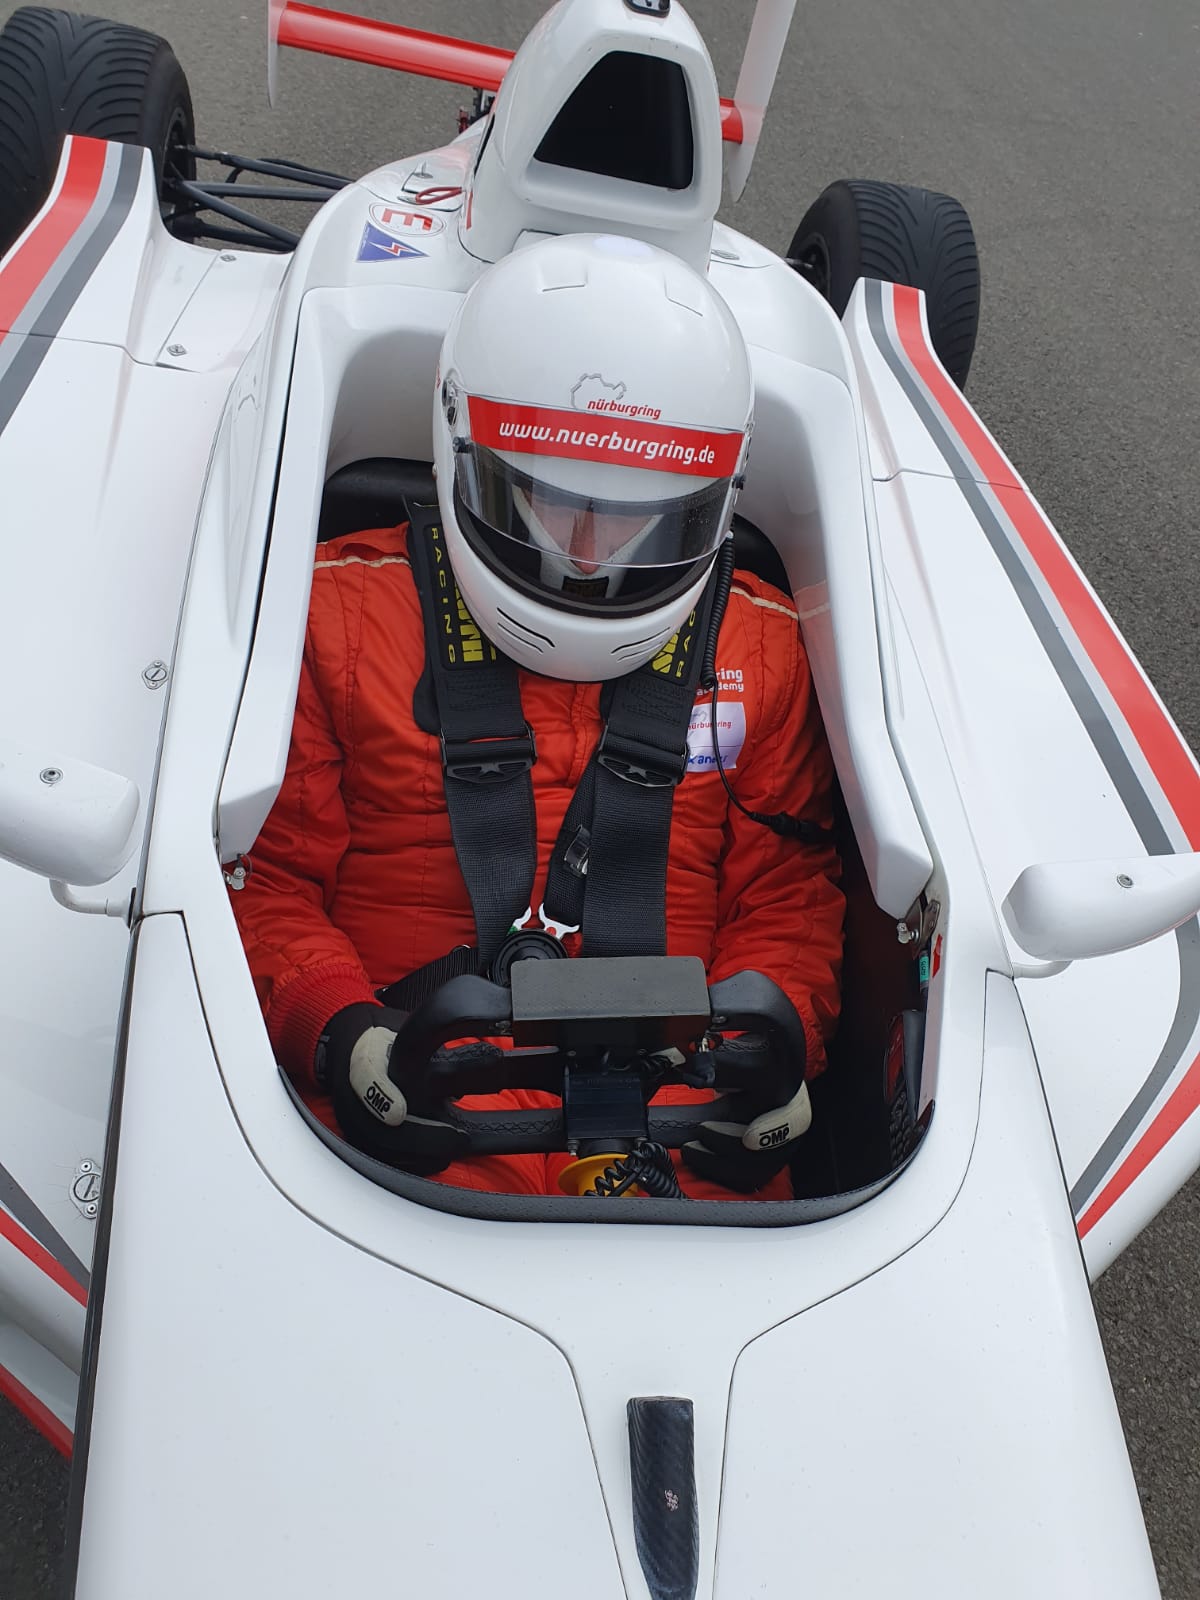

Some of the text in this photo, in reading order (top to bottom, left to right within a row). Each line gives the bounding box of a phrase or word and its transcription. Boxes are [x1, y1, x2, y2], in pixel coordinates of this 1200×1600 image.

[587, 399, 662, 420] nürburgring
[499, 422, 715, 465] www.nuerburgring.de
[431, 528, 456, 664] RACING
[366, 1086, 390, 1112] OMP
[759, 1127, 790, 1146] OMP
